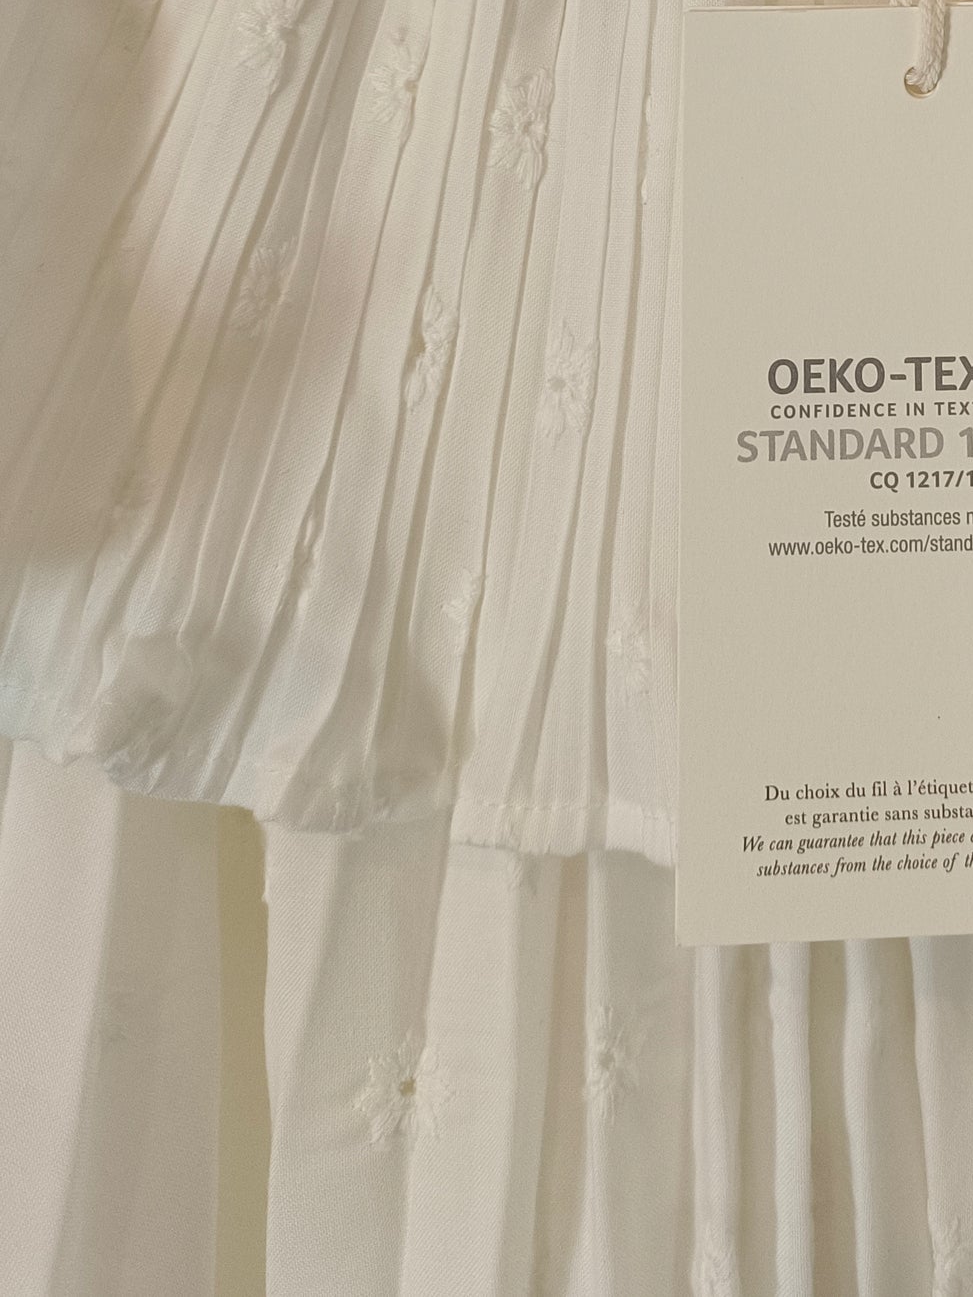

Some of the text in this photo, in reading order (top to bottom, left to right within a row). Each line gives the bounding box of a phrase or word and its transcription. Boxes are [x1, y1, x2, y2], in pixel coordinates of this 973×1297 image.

[771, 402, 898, 420] CONFIDENCE
[906, 402, 925, 417] IN
[737, 427, 945, 464] STANDARD
[869, 471, 899, 494] CQ
[824, 508, 866, 528] Testé
[870, 508, 961, 528] substances
[764, 785, 790, 802] Du
[795, 782, 840, 800] choix
[844, 782, 867, 799] du
[871, 781, 888, 798] fil
[892, 781, 903, 796] à
[784, 810, 807, 825] est
[812, 807, 880, 829] garantie
[884, 807, 919, 821] sans
[742, 835, 764, 853] We
[769, 837, 794, 852] can
[797, 833, 864, 855] guarantee
[869, 831, 897, 847] that
[902, 829, 927, 846] this
[931, 828, 965, 849] piece
[756, 859, 830, 877] substances
[830, 857, 867, 877] from
[871, 856, 892, 873] the
[897, 854, 938, 871] choice
[942, 852, 960, 873] of
